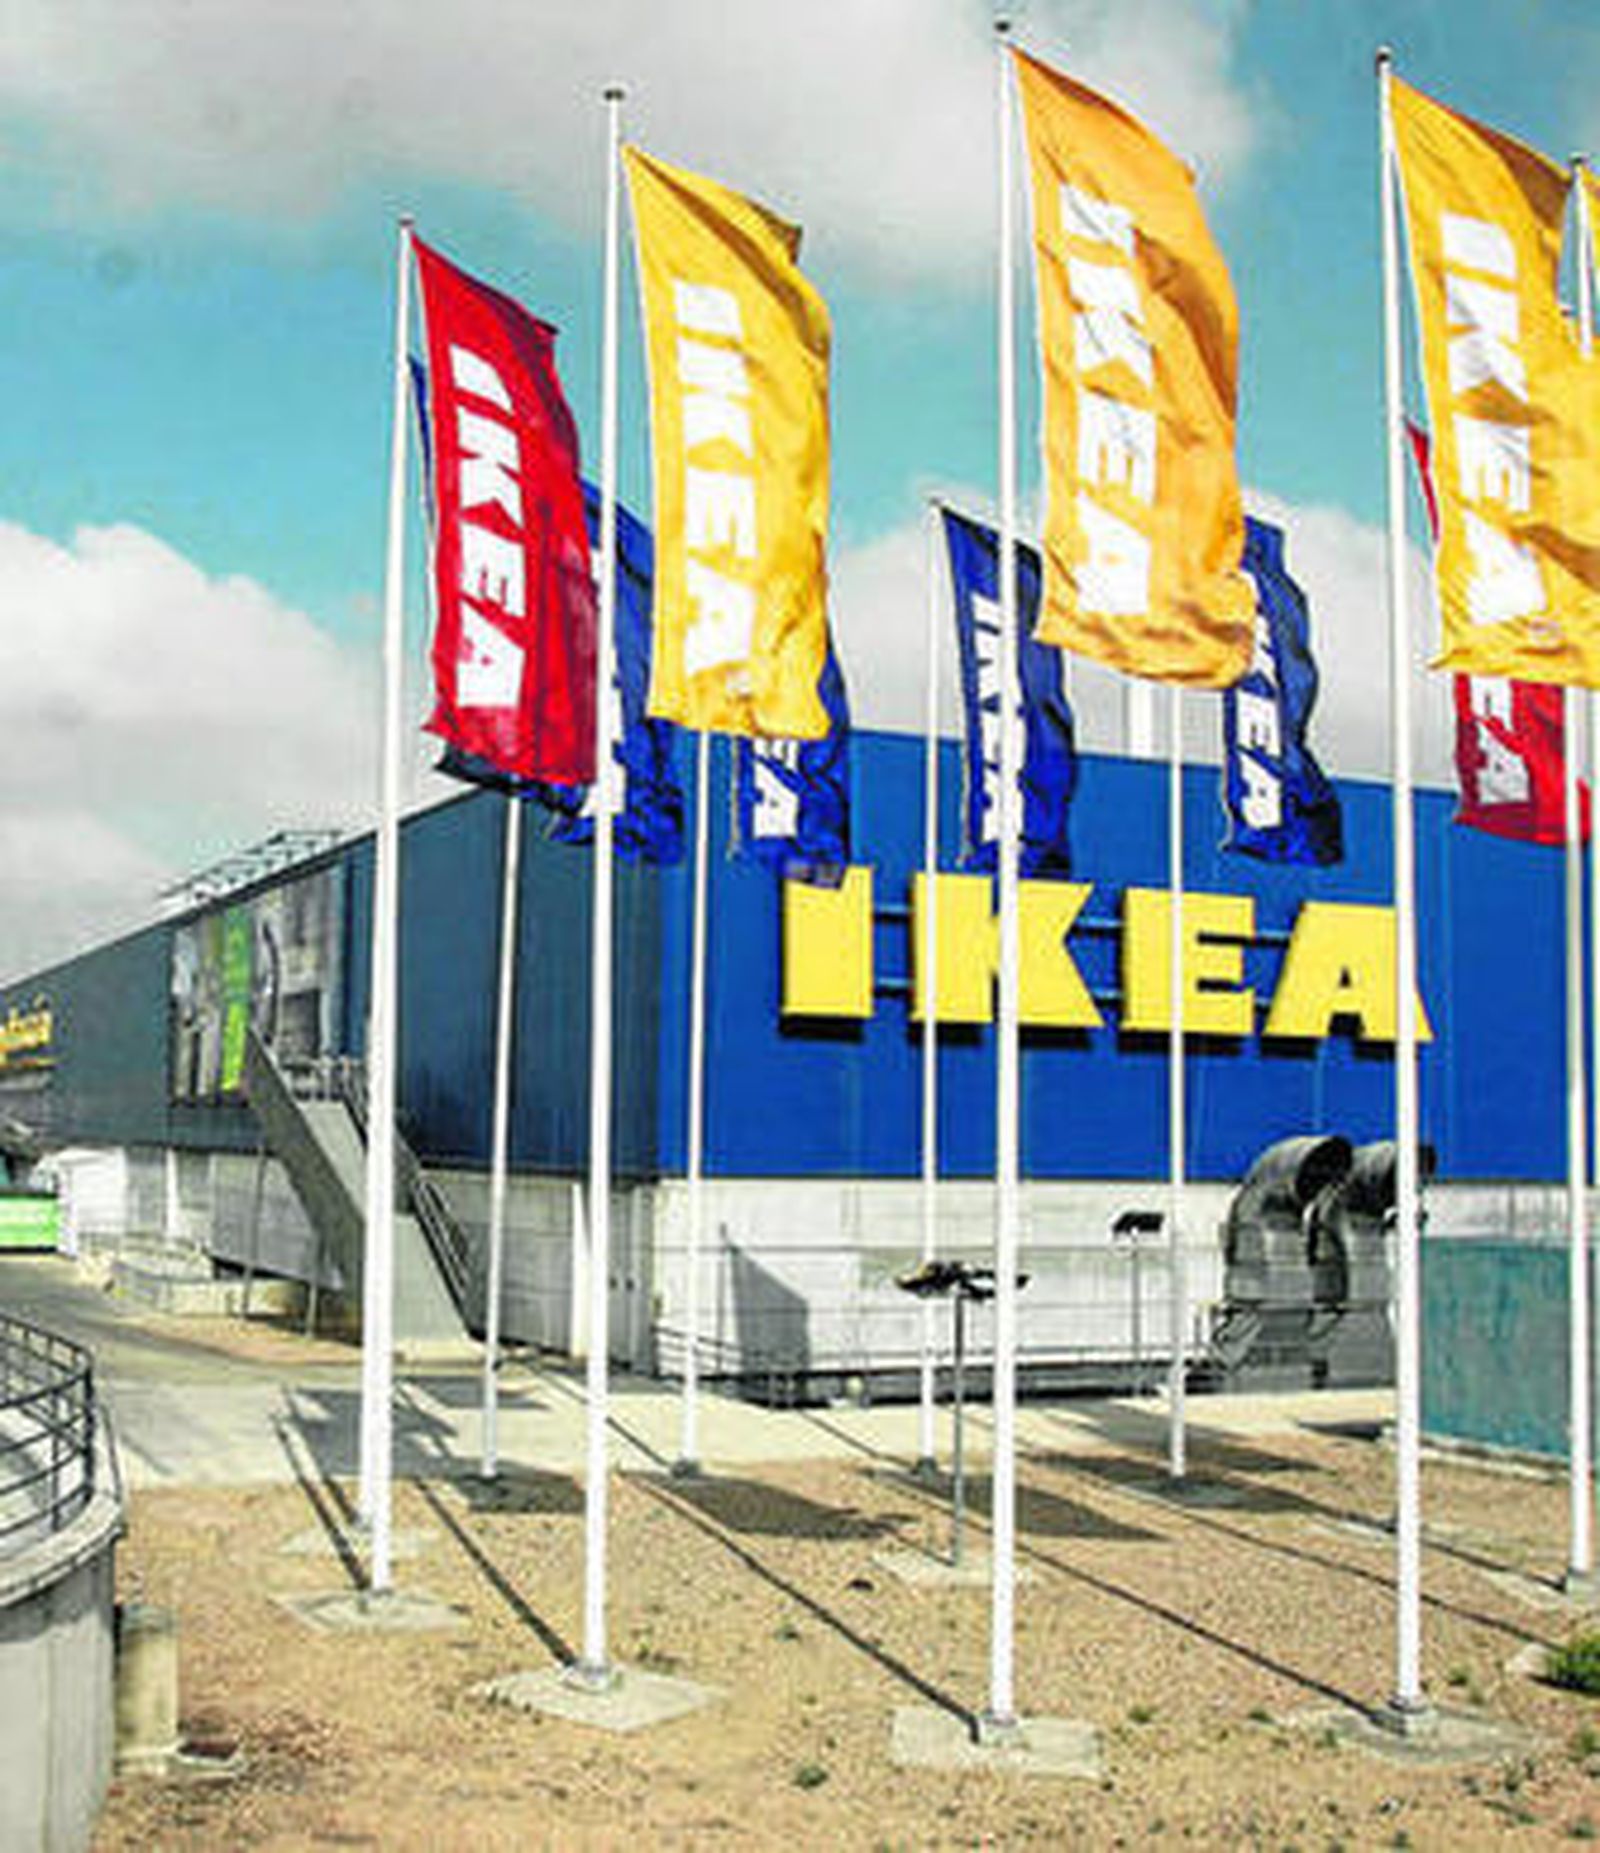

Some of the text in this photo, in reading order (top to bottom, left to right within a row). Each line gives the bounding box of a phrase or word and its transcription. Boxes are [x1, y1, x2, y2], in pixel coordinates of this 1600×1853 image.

[449, 343, 527, 707] IKEA
[673, 279, 757, 677] IKEA
[1060, 182, 1157, 615] IKEA
[1441, 211, 1548, 625] IKEA
[782, 865, 1433, 1042] IKEA
